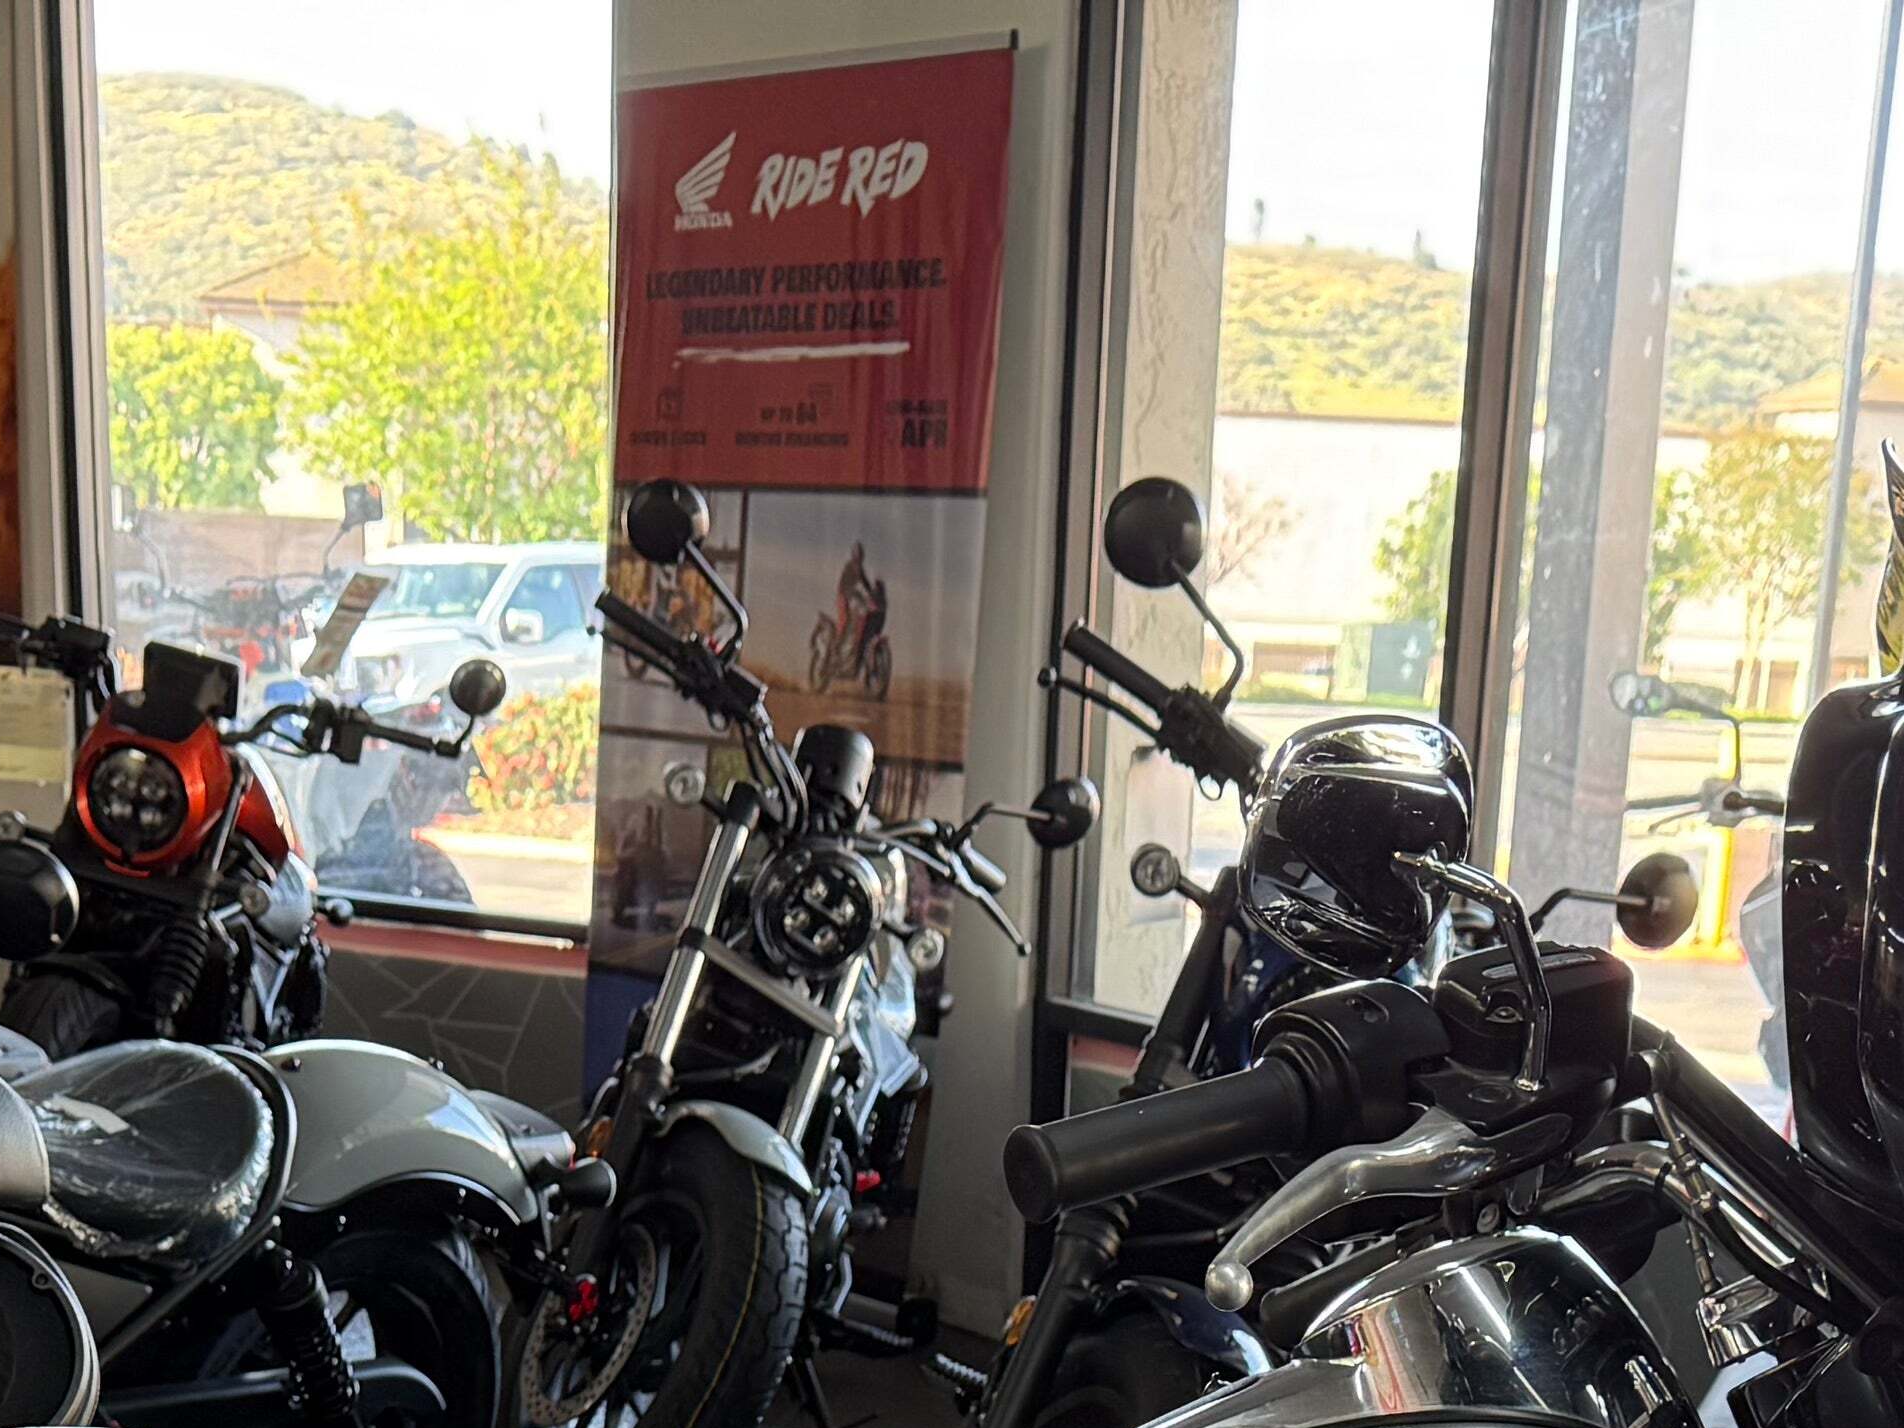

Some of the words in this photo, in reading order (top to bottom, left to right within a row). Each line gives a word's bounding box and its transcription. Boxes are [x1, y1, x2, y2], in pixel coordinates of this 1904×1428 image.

[750, 146, 844, 222] RIDE
[841, 138, 928, 219] RED
[674, 210, 733, 232] HONDA
[646, 265, 766, 299] LEGENDARY
[681, 303, 816, 336] UNBEATABLE
